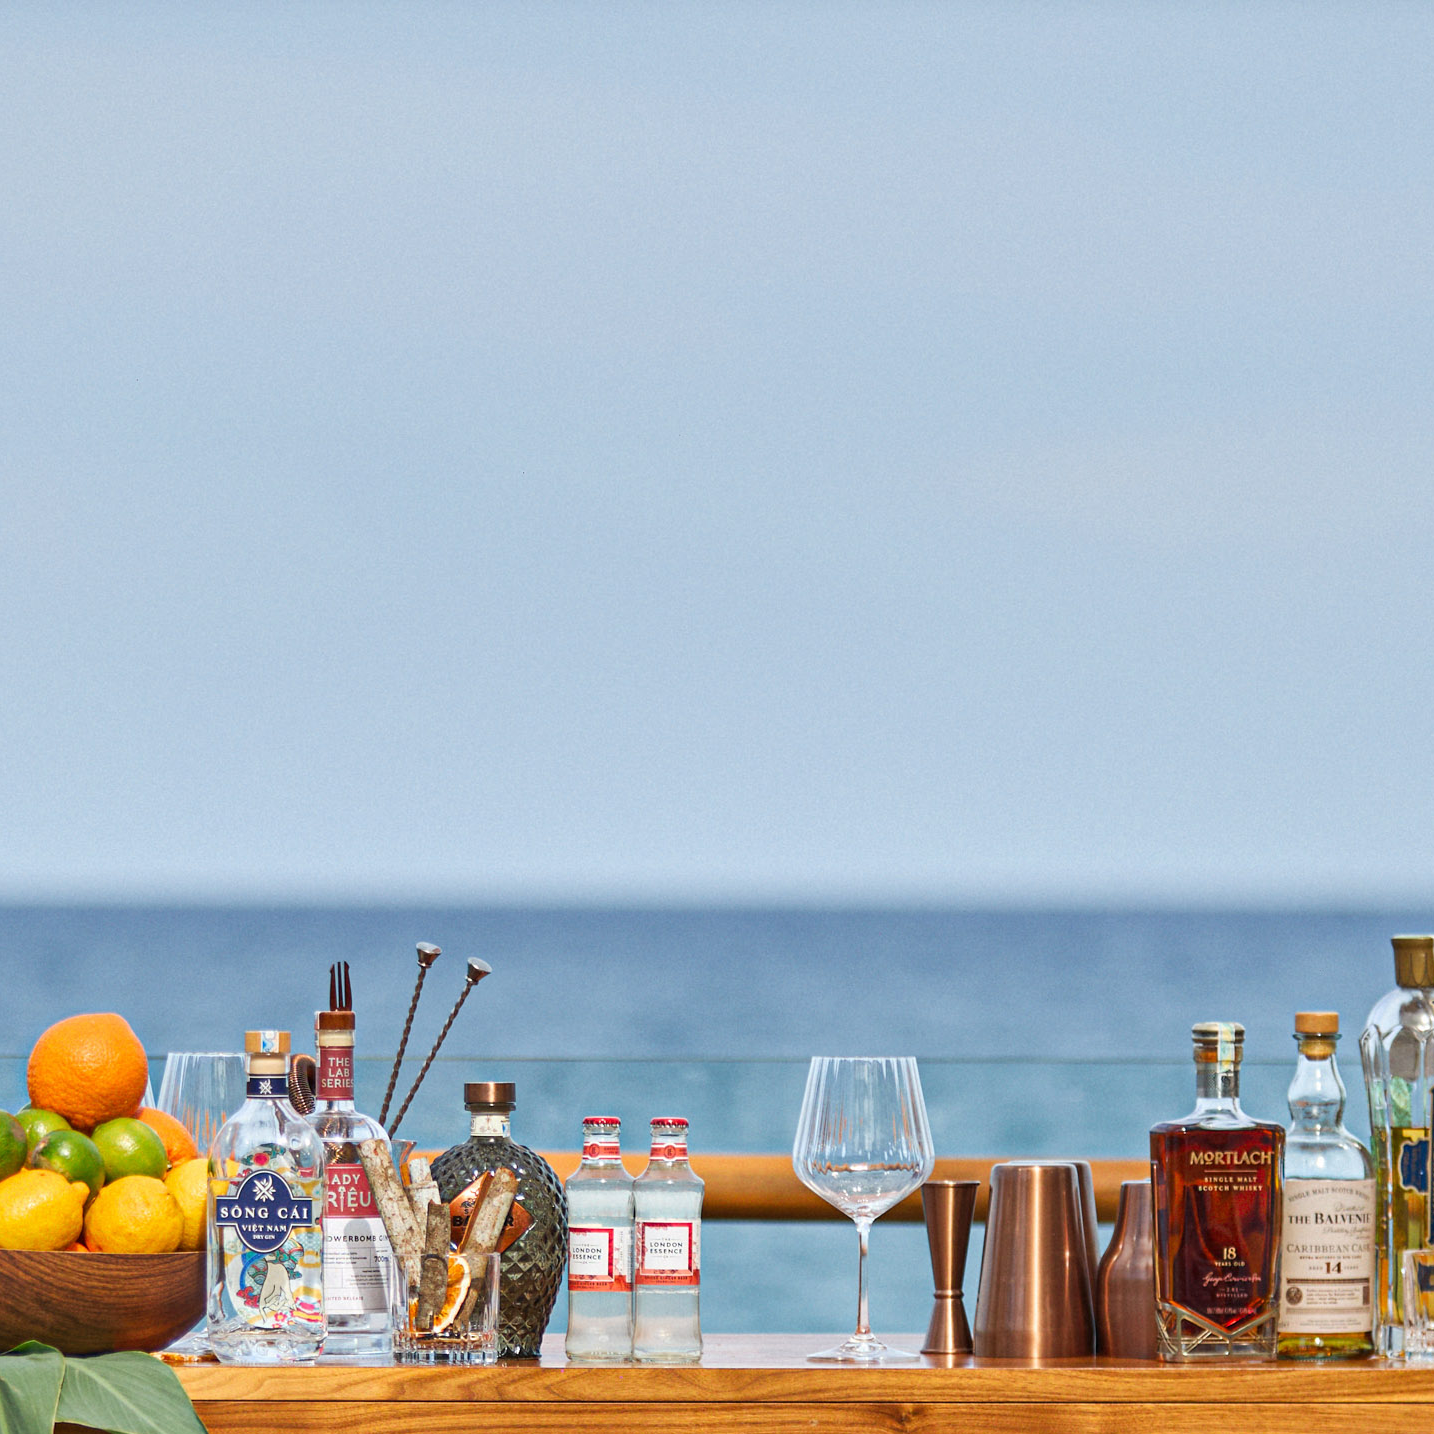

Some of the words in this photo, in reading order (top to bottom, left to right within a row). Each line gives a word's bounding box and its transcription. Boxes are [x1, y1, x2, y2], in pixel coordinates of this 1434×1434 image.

[328, 1057, 350, 1067] THE
[328, 1068, 350, 1077] LAB
[321, 1078, 354, 1088] SERIES
[1190, 1151, 1271, 1165] MORTLACH
[327, 1174, 360, 1185] ADY
[327, 1186, 372, 1212] RIỆU
[220, 1205, 269, 1219] SÔNG
[277, 1205, 309, 1219] CÁI
[1288, 1215, 1311, 1224] THE
[1314, 1212, 1371, 1224] BALVENIE
[241, 1224, 264, 1233] VIỆT
[1223, 1247, 1237, 1260] 18
[1287, 1243, 1349, 1253] CARIBBEAN
[1325, 1262, 1342, 1274] 14
